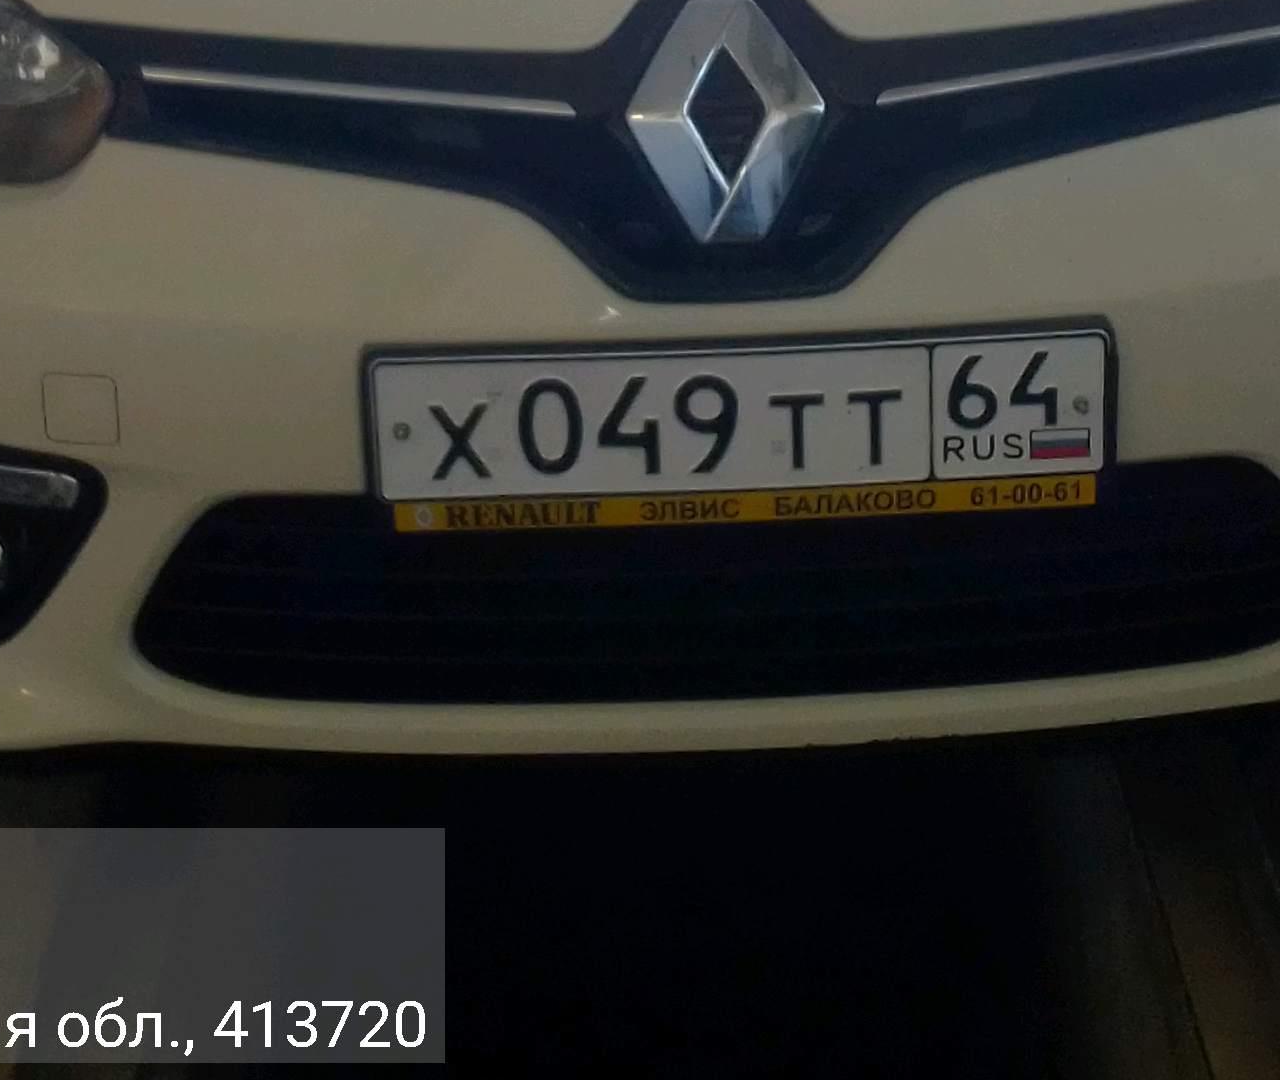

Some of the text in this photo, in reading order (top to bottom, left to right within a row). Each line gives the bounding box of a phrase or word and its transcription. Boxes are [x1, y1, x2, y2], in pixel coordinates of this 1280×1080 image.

[946, 351, 1059, 431] 64
[941, 433, 1026, 463] RUS
[444, 480, 1082, 527] RENAULT ЭЛВИС БАЛАКОВО 61-00-61
